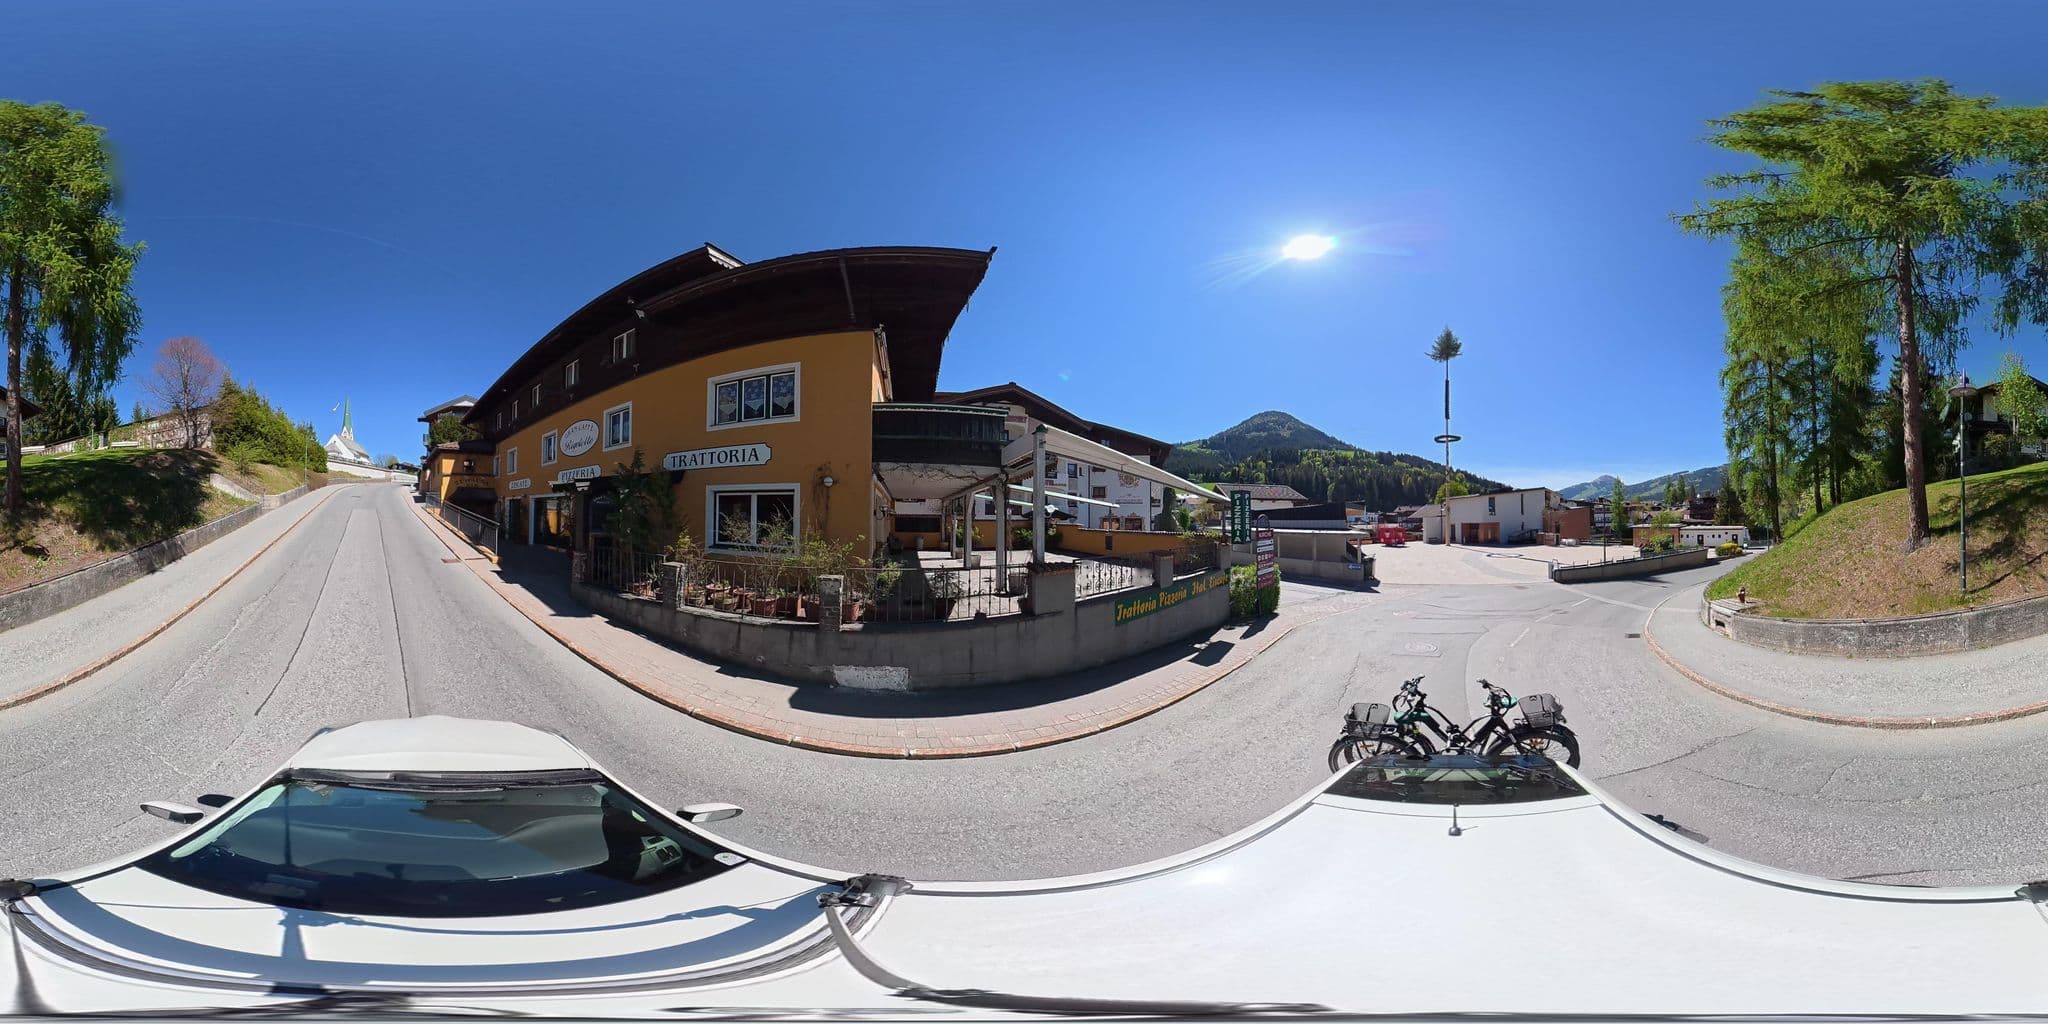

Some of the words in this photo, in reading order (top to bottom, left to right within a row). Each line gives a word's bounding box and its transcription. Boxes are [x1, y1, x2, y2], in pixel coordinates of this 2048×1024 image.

[670, 448, 760, 469] TRATTORIA
[561, 467, 595, 483] PIZZERIA
[1116, 597, 1157, 622] Trattoria
[1159, 586, 1188, 607] Pizzeria
